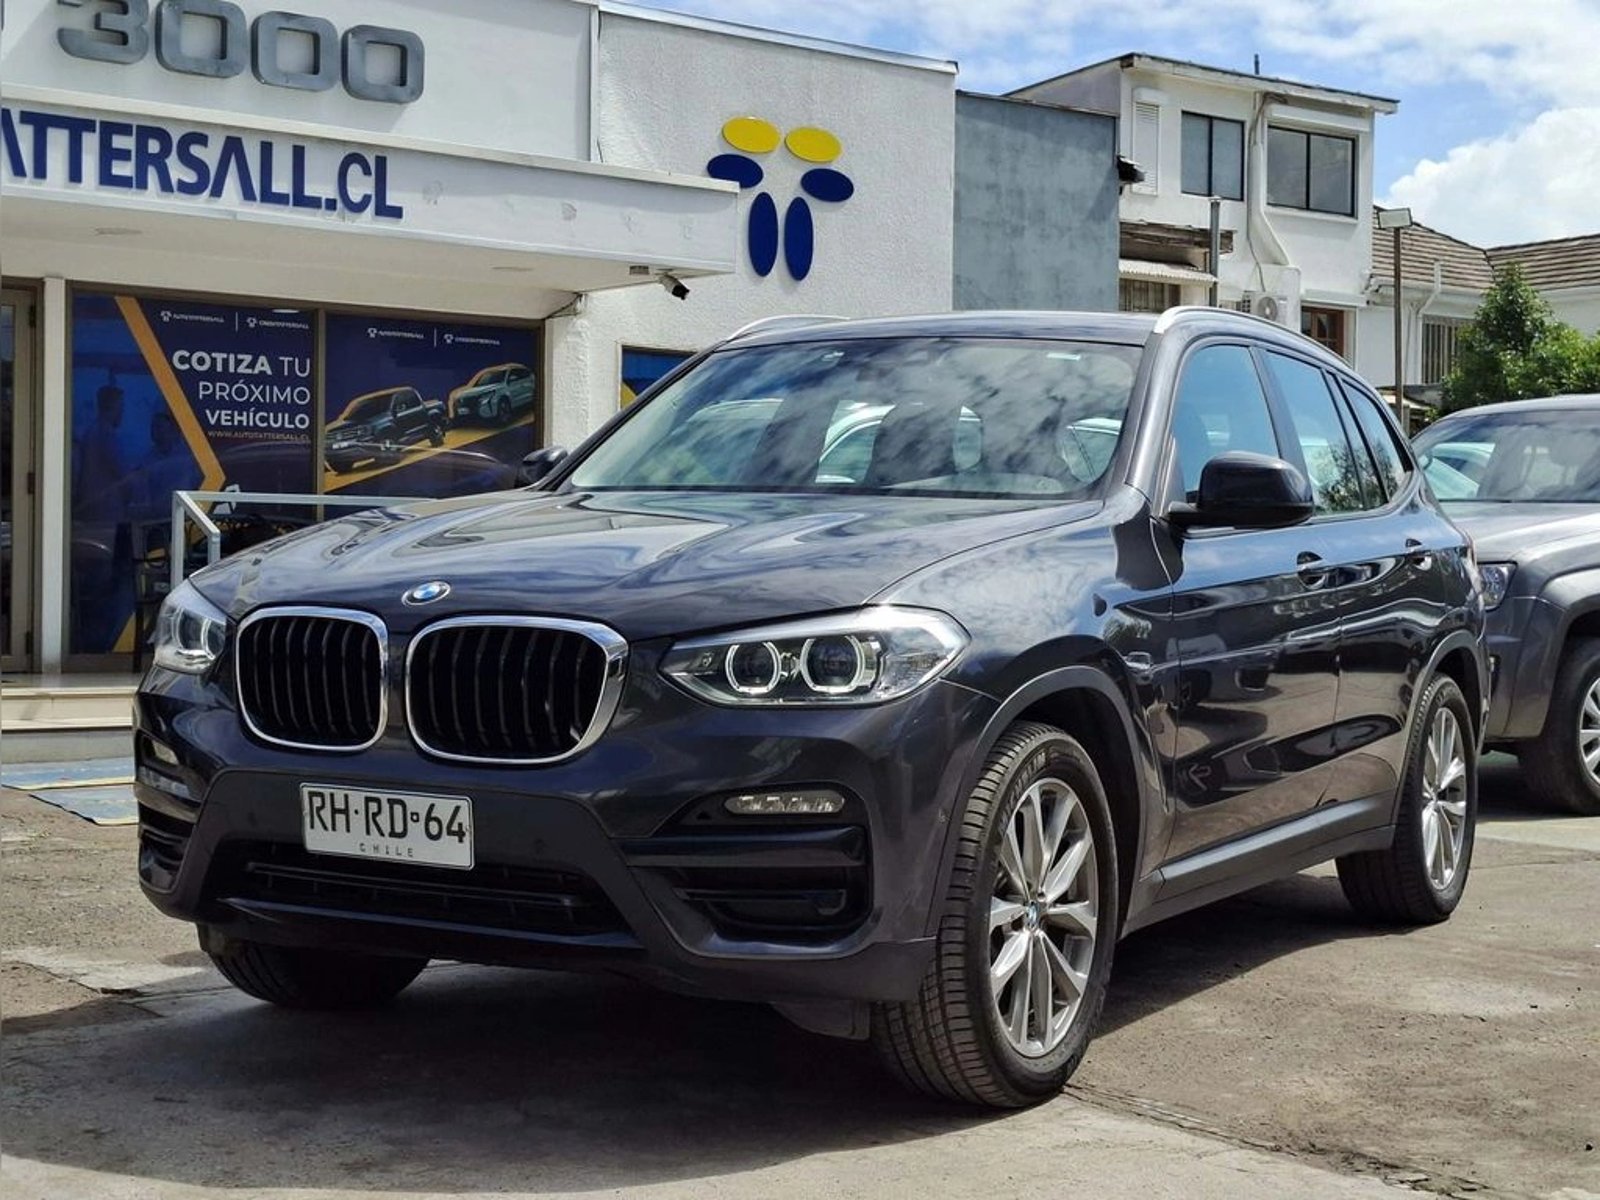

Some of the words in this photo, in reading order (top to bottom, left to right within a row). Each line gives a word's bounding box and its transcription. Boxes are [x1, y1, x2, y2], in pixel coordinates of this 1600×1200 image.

[56, 0, 425, 103] 3000
[172, 350, 272, 375] COTIZA
[279, 356, 310, 377] TU
[199, 379, 310, 405] PRÓXIMO
[205, 407, 310, 429] VEHÍCULO
[359, 842, 413, 857] CHILE
